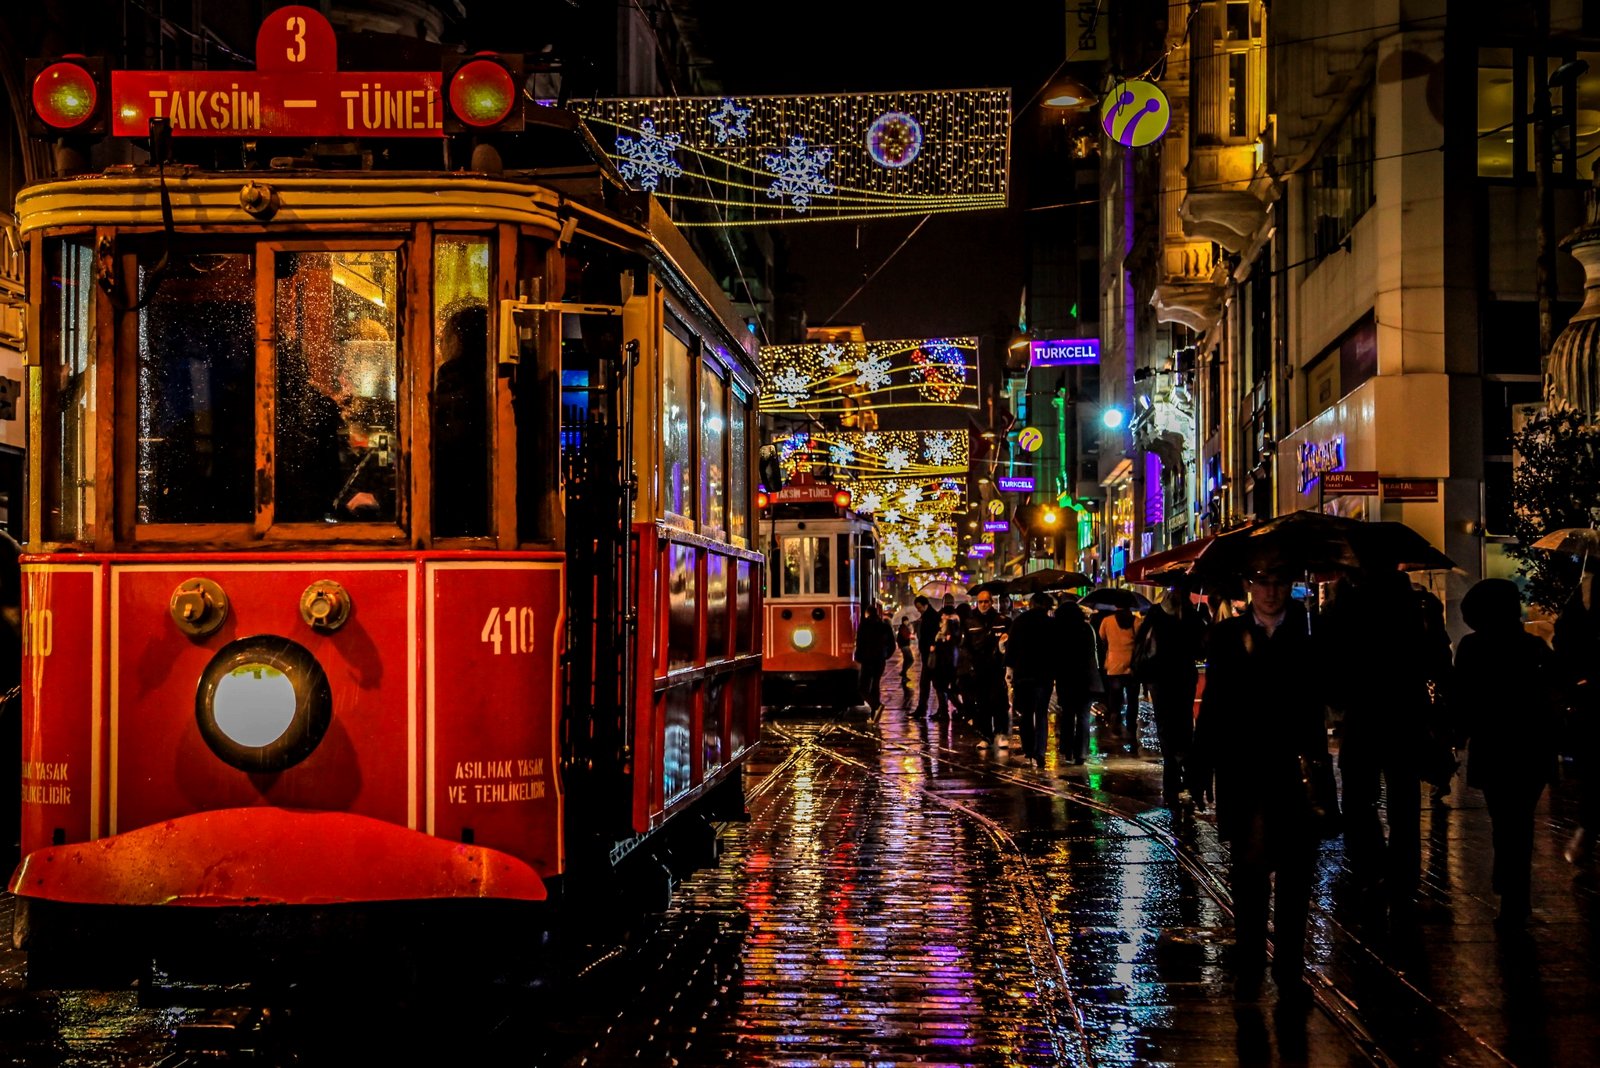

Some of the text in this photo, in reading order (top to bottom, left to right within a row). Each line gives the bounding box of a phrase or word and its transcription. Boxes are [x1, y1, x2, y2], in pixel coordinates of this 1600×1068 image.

[286, 16, 307, 63] 3
[148, 82, 261, 130] TAKSİM
[340, 82, 443, 130] TÜNEL
[1034, 345, 1096, 360] TURKCELL
[1001, 480, 1033, 489] TURKCELL
[1325, 474, 1354, 482] KARTAL
[808, 486, 832, 498] TÜNEL
[481, 606, 535, 656] 410
[35, 761, 69, 782] YASAK
[455, 757, 544, 780] ASILMAK YASAK
[448, 785, 468, 805] VE
